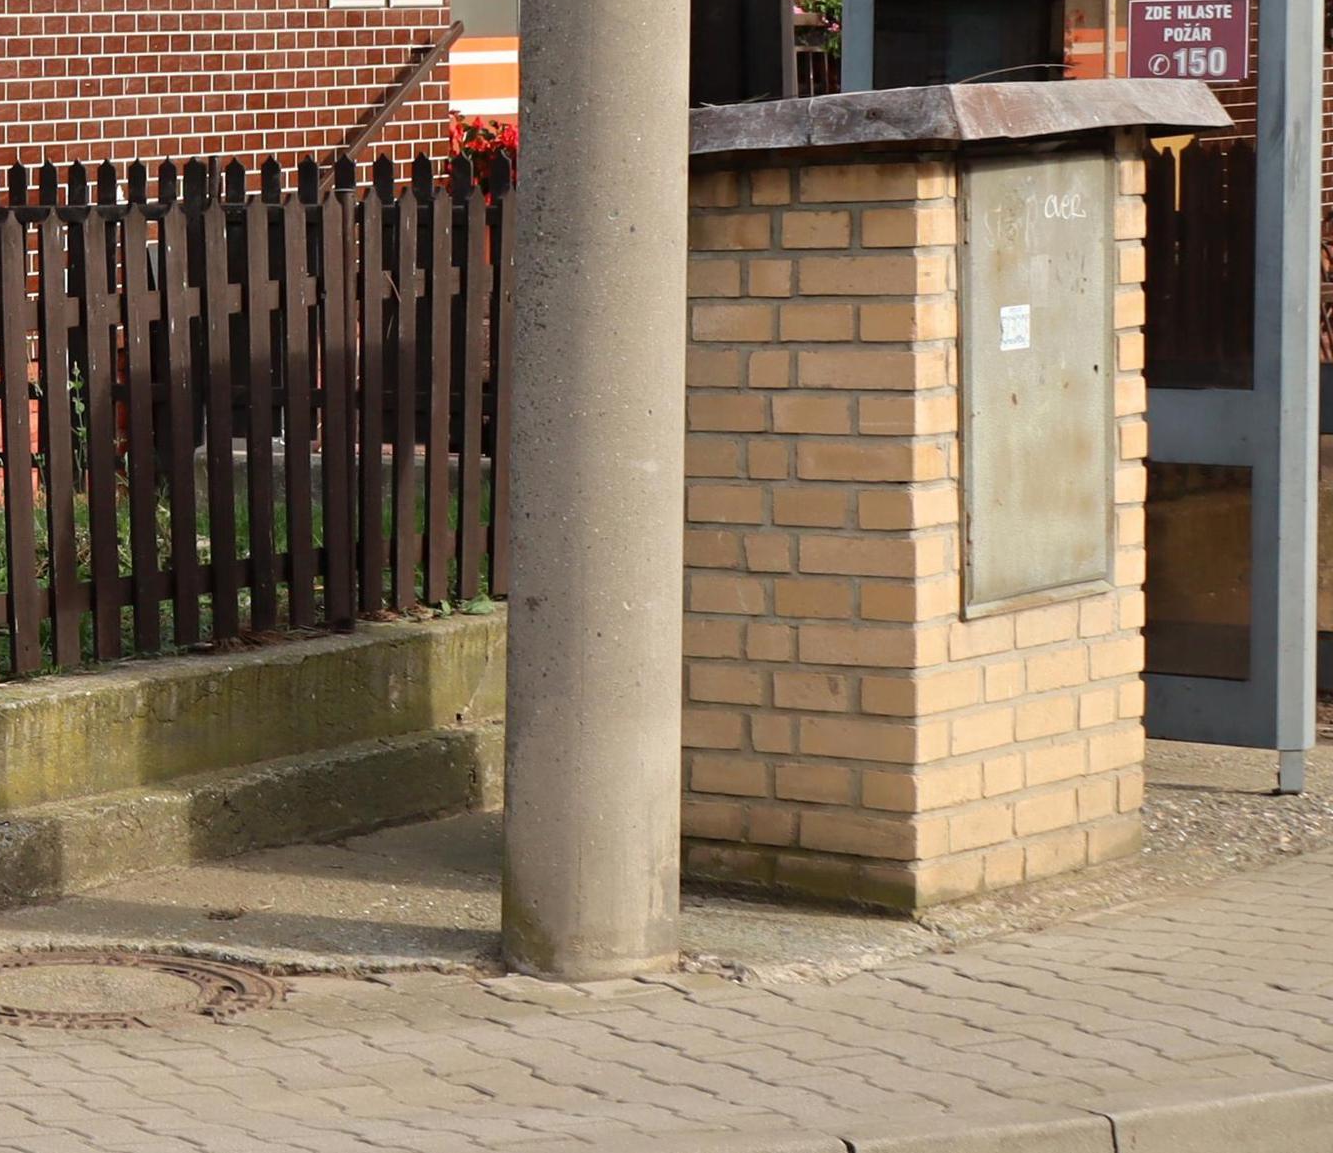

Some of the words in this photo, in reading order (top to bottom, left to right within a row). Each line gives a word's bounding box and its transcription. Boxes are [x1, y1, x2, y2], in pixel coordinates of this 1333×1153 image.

[1145, 6, 1172, 20] ZDE
[1177, 4, 1232, 19] HLASTE
[1163, 23, 1211, 42] POŽÁR
[1173, 47, 1227, 76] 150
